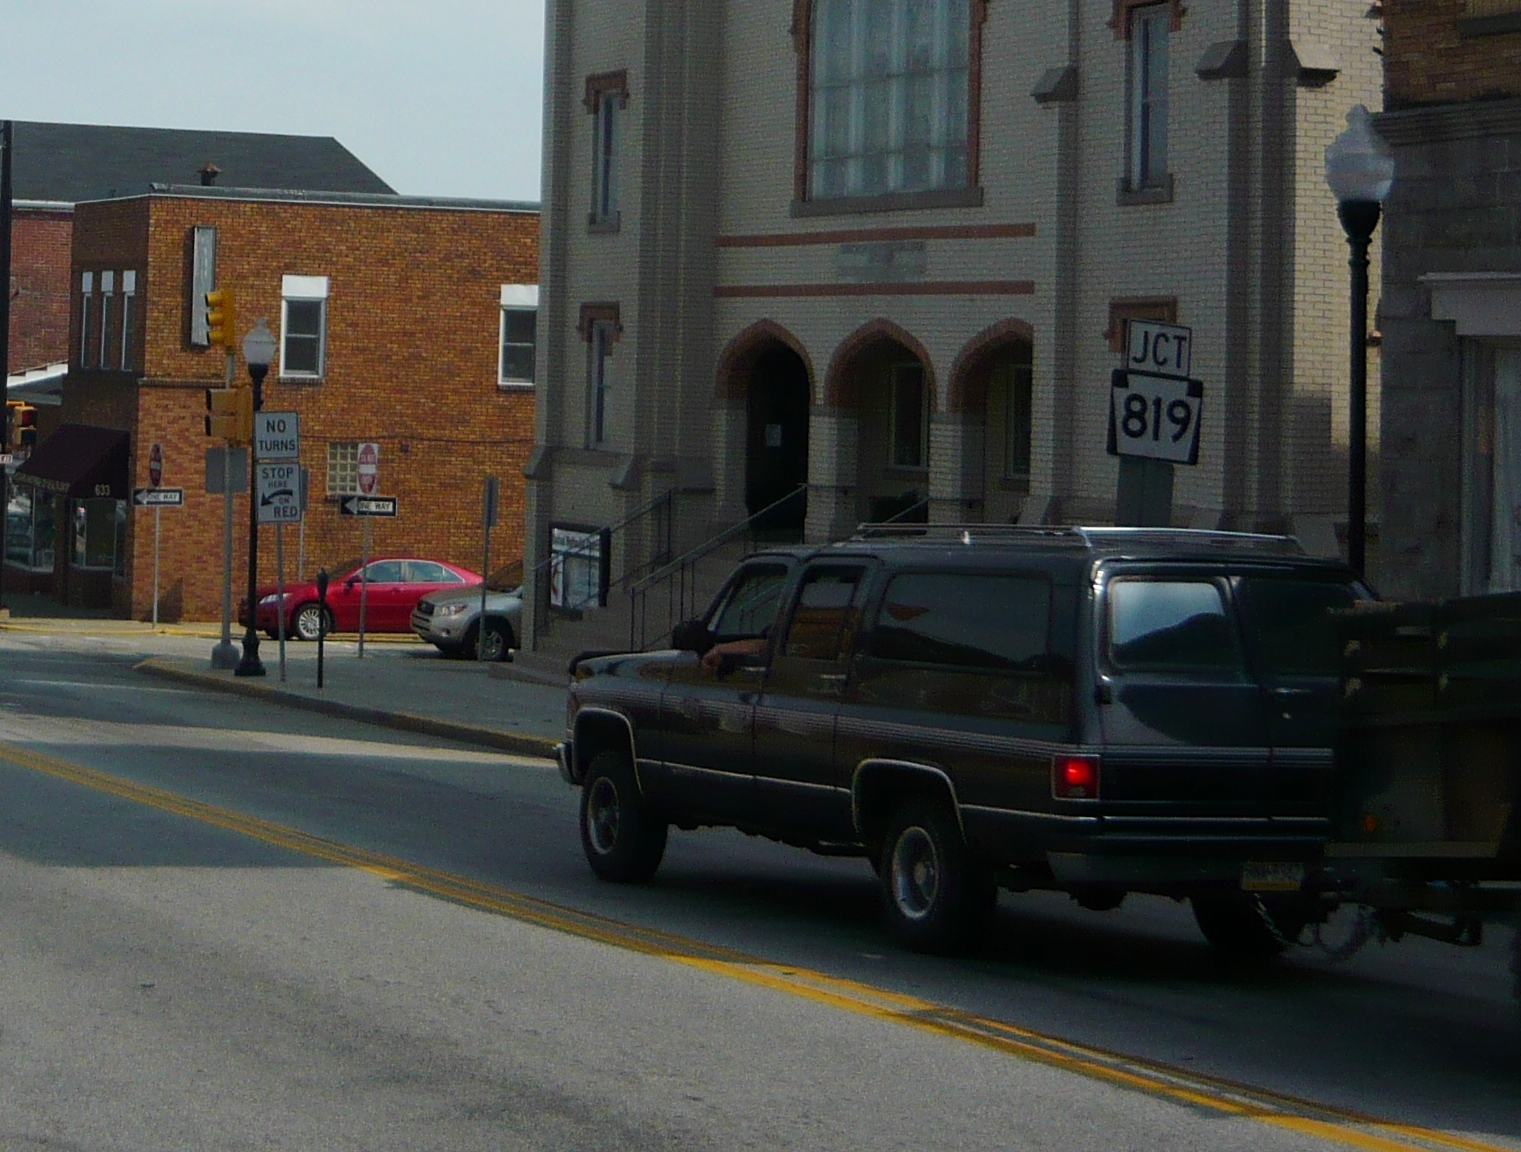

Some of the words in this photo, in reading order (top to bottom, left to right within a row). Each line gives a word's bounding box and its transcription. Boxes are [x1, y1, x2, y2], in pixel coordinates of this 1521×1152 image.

[1132, 330, 1188, 369] JCT
[1122, 393, 1192, 444] 819
[266, 419, 286, 433] NO
[259, 440, 296, 452] TURNS
[262, 468, 294, 479] STOP
[273, 506, 298, 518] RED
